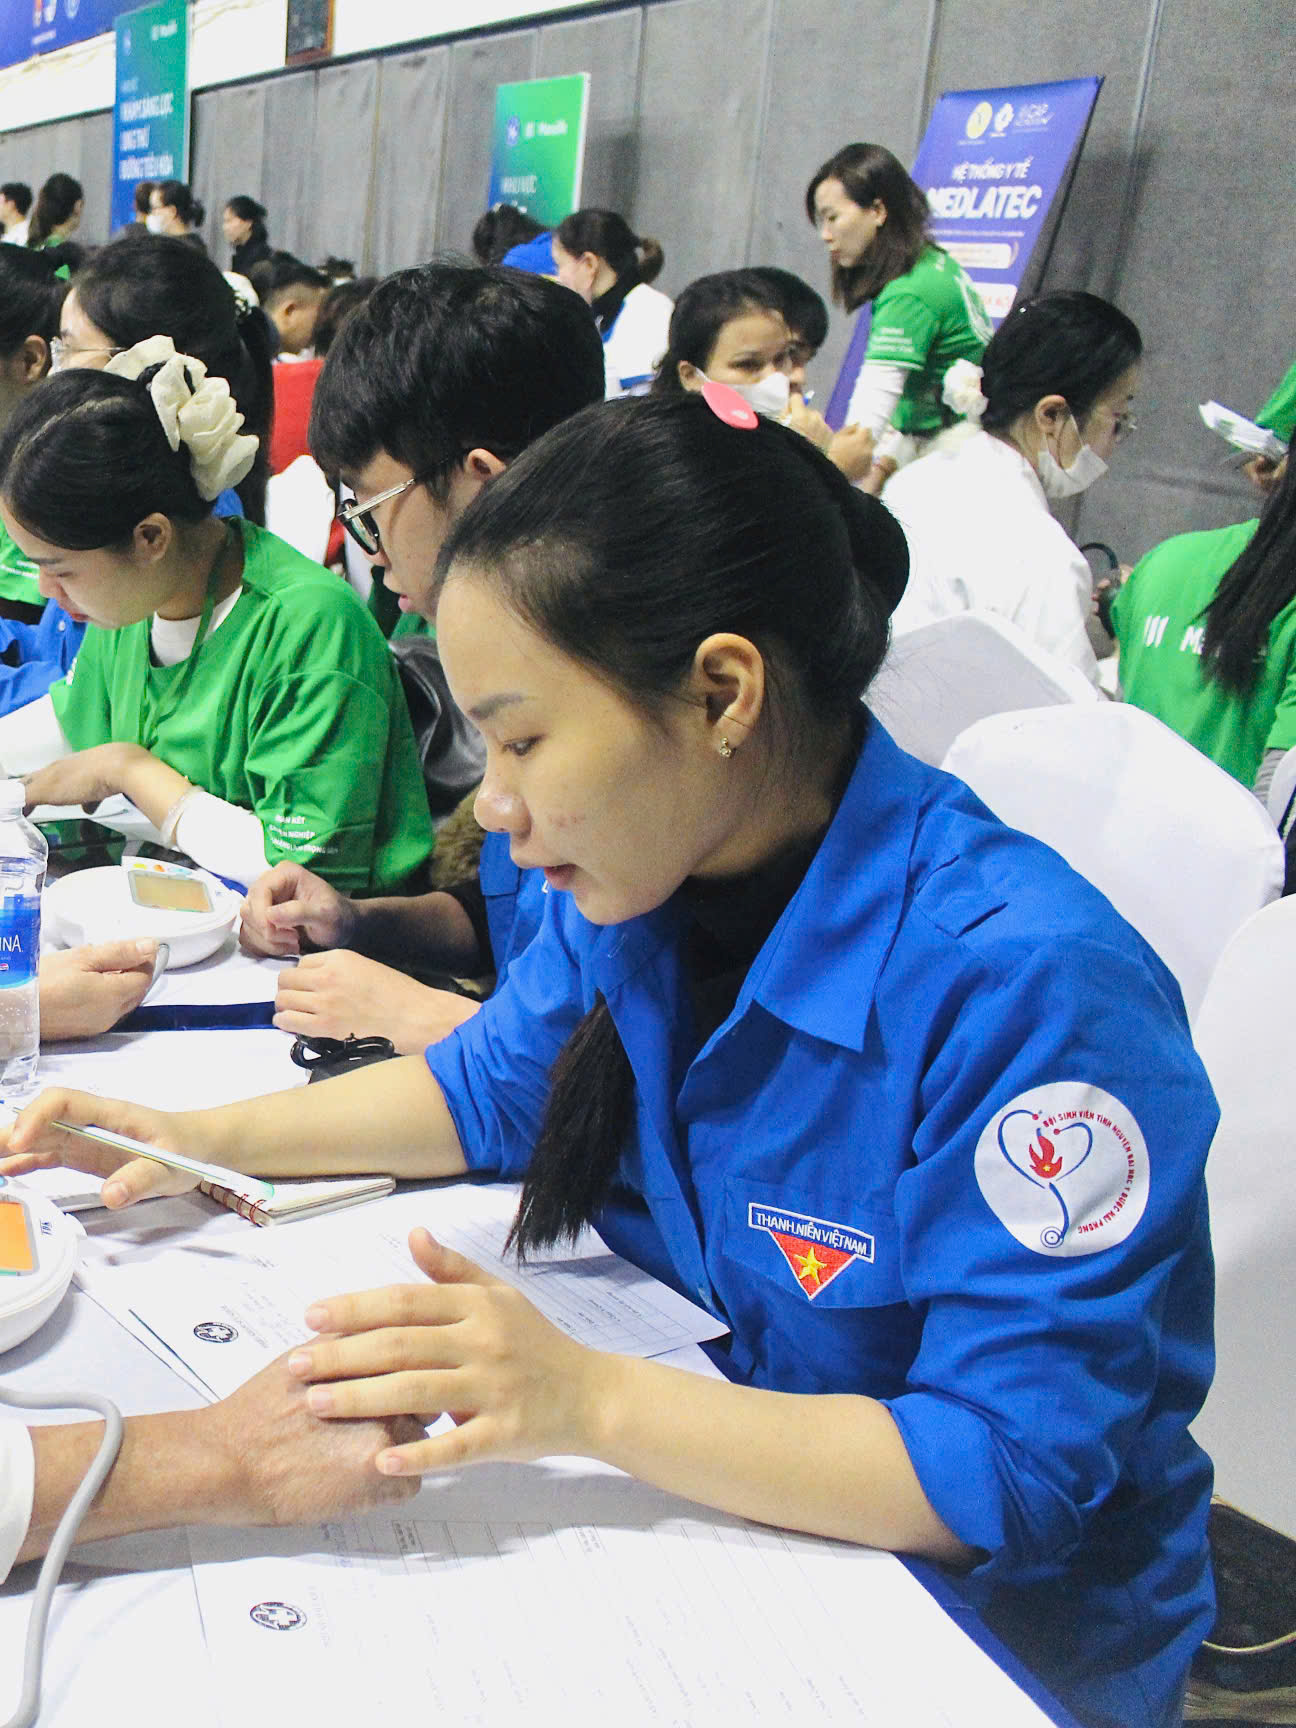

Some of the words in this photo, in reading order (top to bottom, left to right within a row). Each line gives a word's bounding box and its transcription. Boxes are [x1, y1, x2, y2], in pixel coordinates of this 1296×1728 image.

[927, 185, 1042, 219] MEDLATEC
[756, 1212, 793, 1233] THANH
[795, 1221, 822, 1241] NIÊN
[822, 1229, 844, 1249] VIỆT
[843, 1236, 867, 1255] NAM
